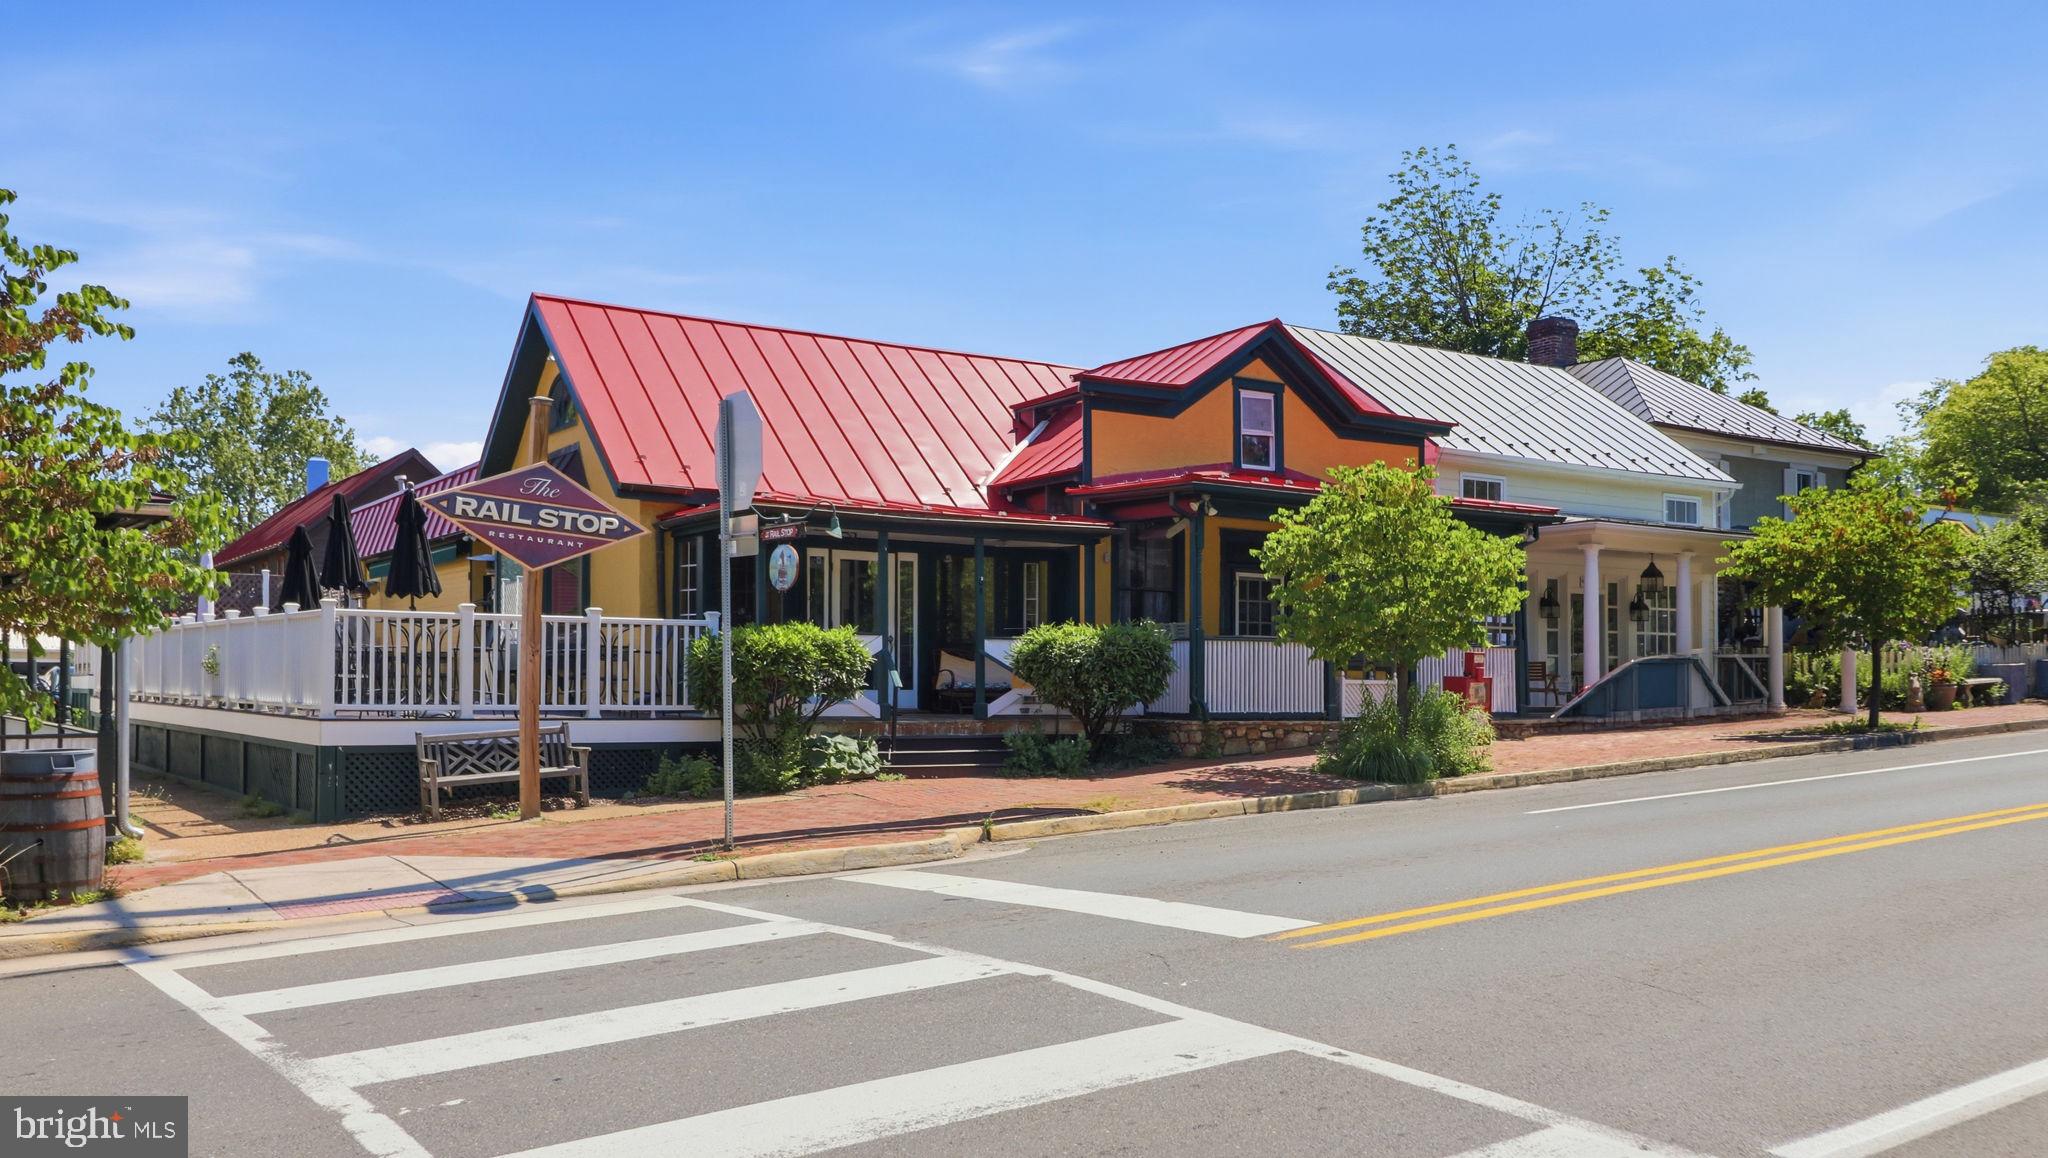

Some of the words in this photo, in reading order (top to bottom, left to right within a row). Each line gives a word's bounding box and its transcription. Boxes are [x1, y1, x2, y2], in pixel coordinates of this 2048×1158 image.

[520, 477, 562, 498] The
[454, 496, 532, 526] RAIL
[537, 508, 620, 536] STOP
[488, 530, 584, 548] RESTAURANT
